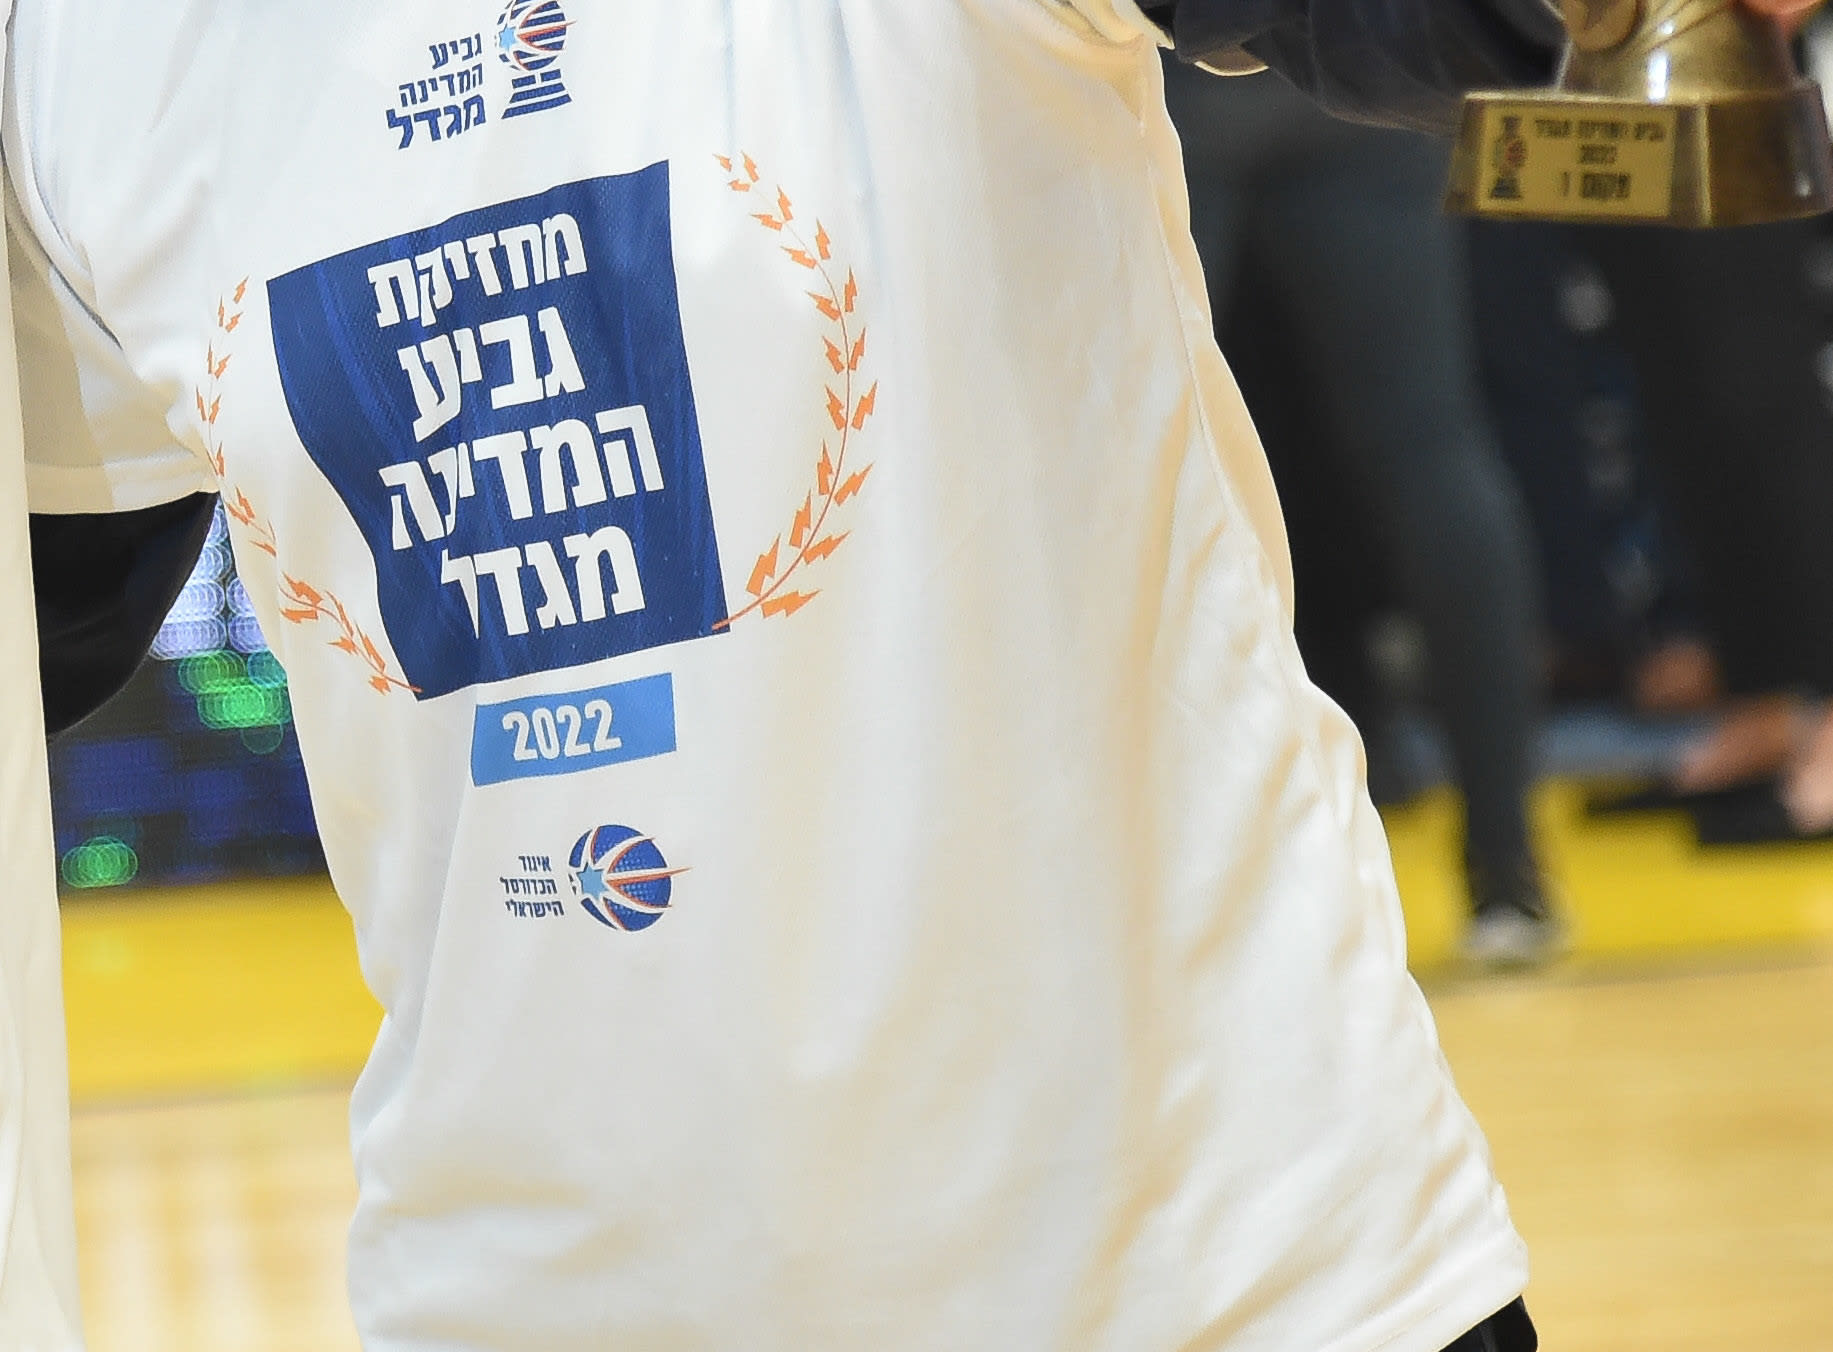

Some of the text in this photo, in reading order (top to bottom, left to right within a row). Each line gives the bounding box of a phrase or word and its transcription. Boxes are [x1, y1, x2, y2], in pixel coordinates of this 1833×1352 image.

[429, 32, 482, 69] גביע
[399, 63, 483, 107] המדינה
[386, 94, 486, 150] מגדל
[367, 212, 588, 328] מחזיקת
[396, 306, 586, 442] גביע
[378, 404, 664, 550] המדינה
[440, 525, 646, 639] מגדל
[502, 699, 622, 761] 2022
[499, 876, 558, 895] הכדורסל
[518, 855, 552, 872] איגוד
[505, 899, 564, 918] הישראלי
